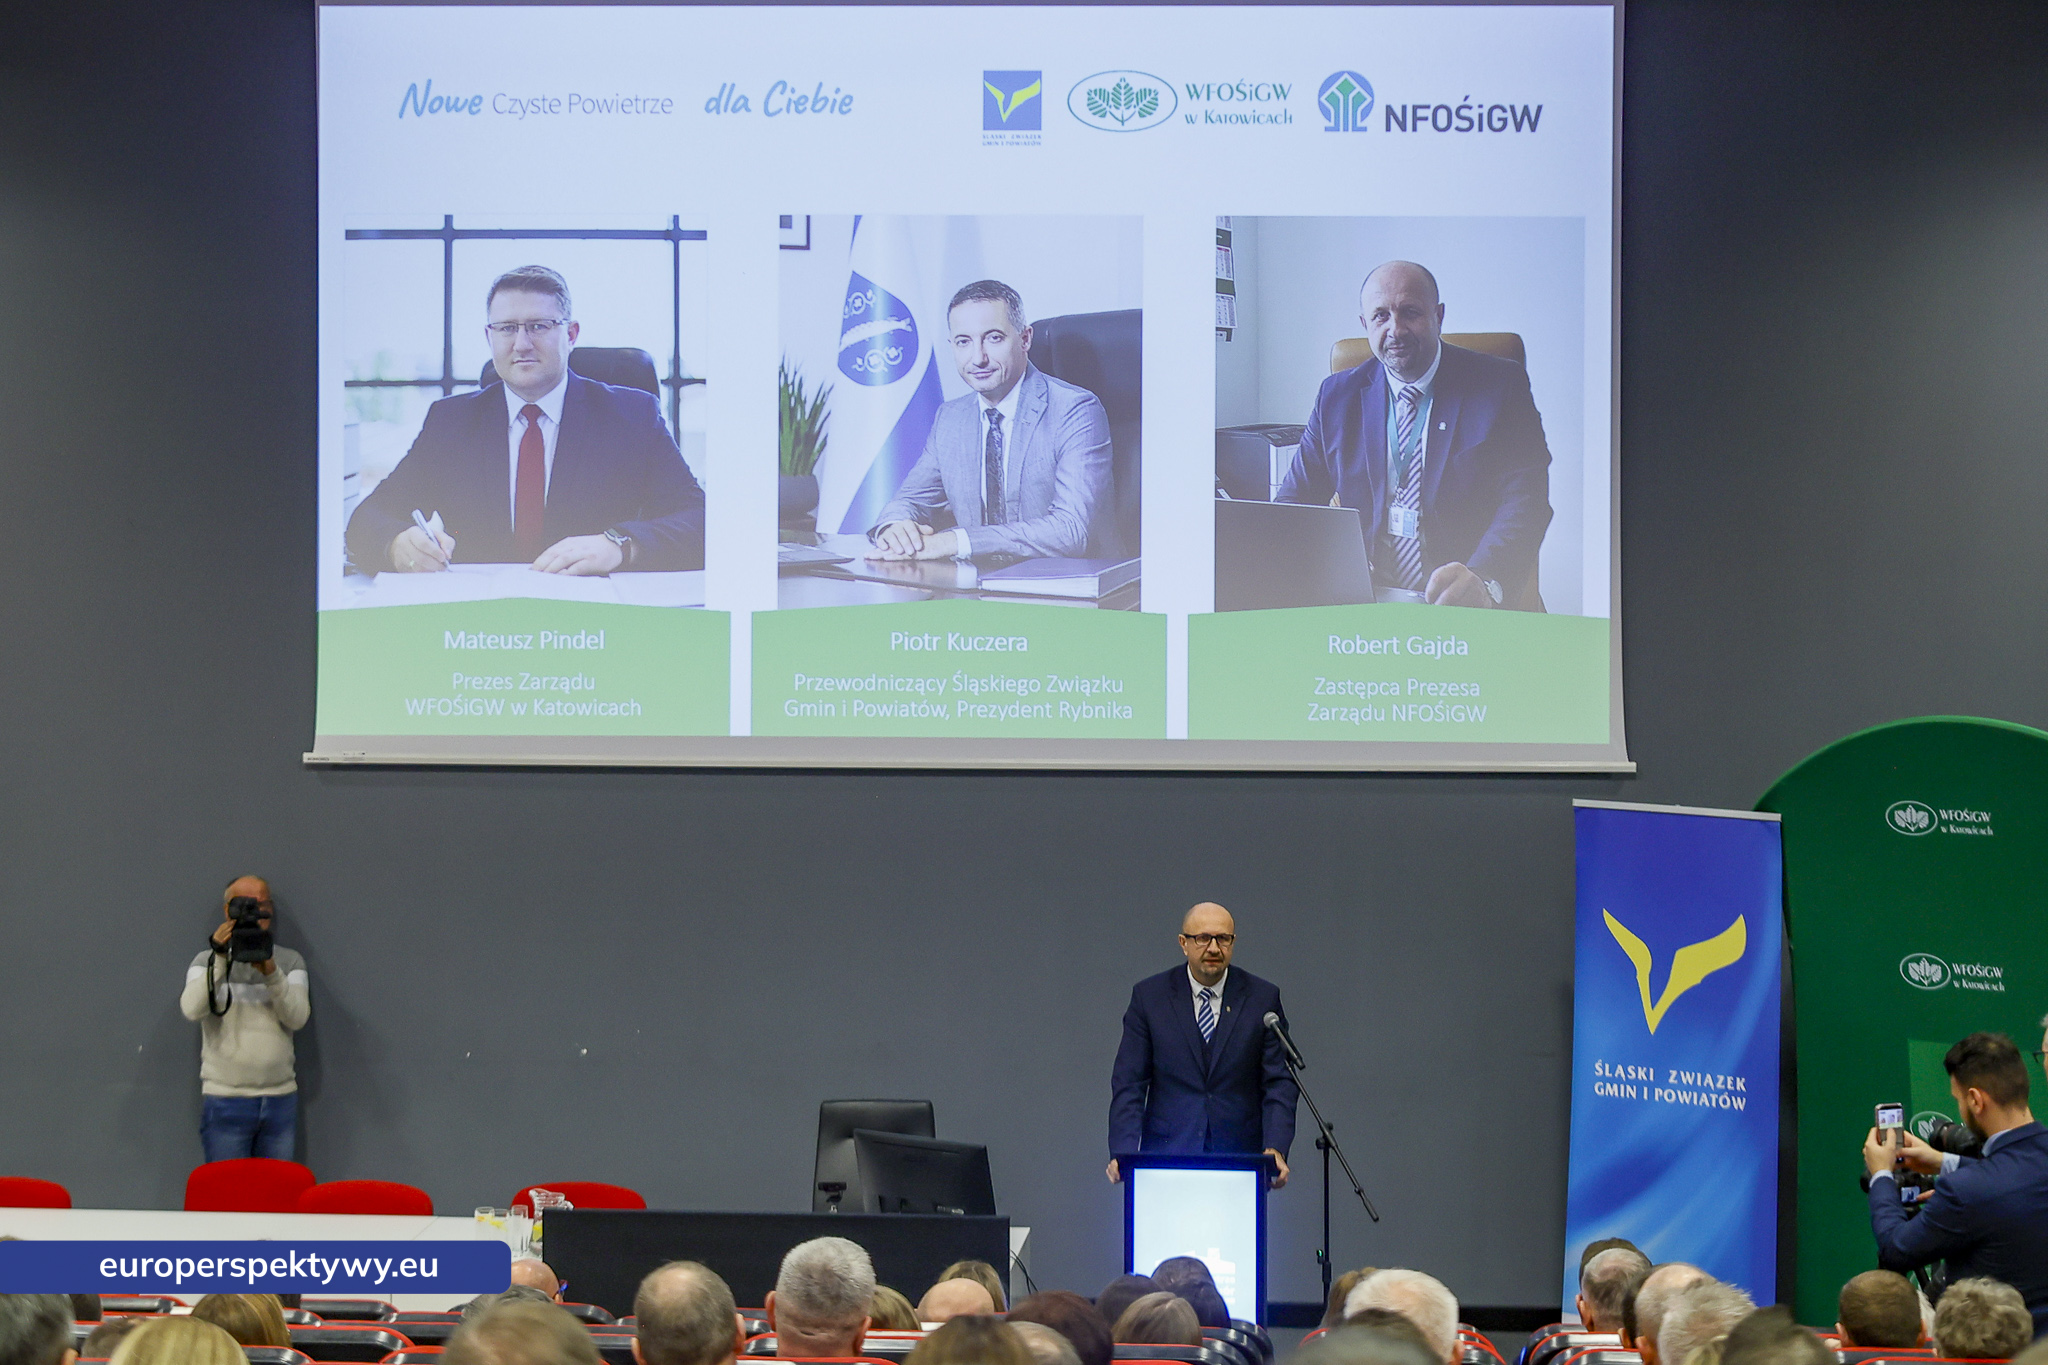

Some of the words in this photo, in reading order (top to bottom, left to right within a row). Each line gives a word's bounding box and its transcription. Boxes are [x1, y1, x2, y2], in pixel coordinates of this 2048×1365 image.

[398, 78, 482, 118] Nowe
[492, 92, 561, 120] Czyste
[568, 92, 673, 115] Powietrze
[704, 82, 751, 115] dla
[764, 80, 854, 117] Ciebie
[1185, 77, 1292, 102] WFOŚiGW
[1184, 114, 1198, 125] w
[1385, 94, 1543, 133] NFOŚiGW
[444, 630, 533, 650] Mateusz
[540, 629, 605, 650] Pindel
[891, 631, 942, 651] Piotr
[948, 632, 1028, 652] Kuczera
[1328, 634, 1400, 655] Robert
[1406, 635, 1469, 660] Gajda
[452, 672, 514, 691] Prezes
[518, 672, 595, 694] Zarządu
[794, 672, 947, 696] Przewodniczący
[952, 670, 1042, 695] Śląskiego
[1046, 674, 1124, 696] Związku
[1313, 677, 1400, 699] Zastępca
[1407, 678, 1481, 697] Prezesa
[404, 693, 506, 716] WFOŚiGW
[510, 701, 528, 716] w
[533, 698, 642, 716] Katowicach
[784, 699, 836, 718] Gmin
[842, 699, 847, 717] i
[853, 698, 951, 721] Powiatów,
[957, 700, 1053, 721] Prezydent
[1059, 700, 1134, 722] Rybnika
[1307, 702, 1385, 725] Zarządu
[1392, 700, 1487, 723] NFOŚiGW
[1594, 1058, 1655, 1082] ŚLĄSKI
[1668, 1069, 1747, 1093] ZWIĄZEK
[1594, 1081, 1637, 1100] GMIN
[1643, 1087, 1649, 1101] I
[1654, 1087, 1747, 1112] POWIATÓW
